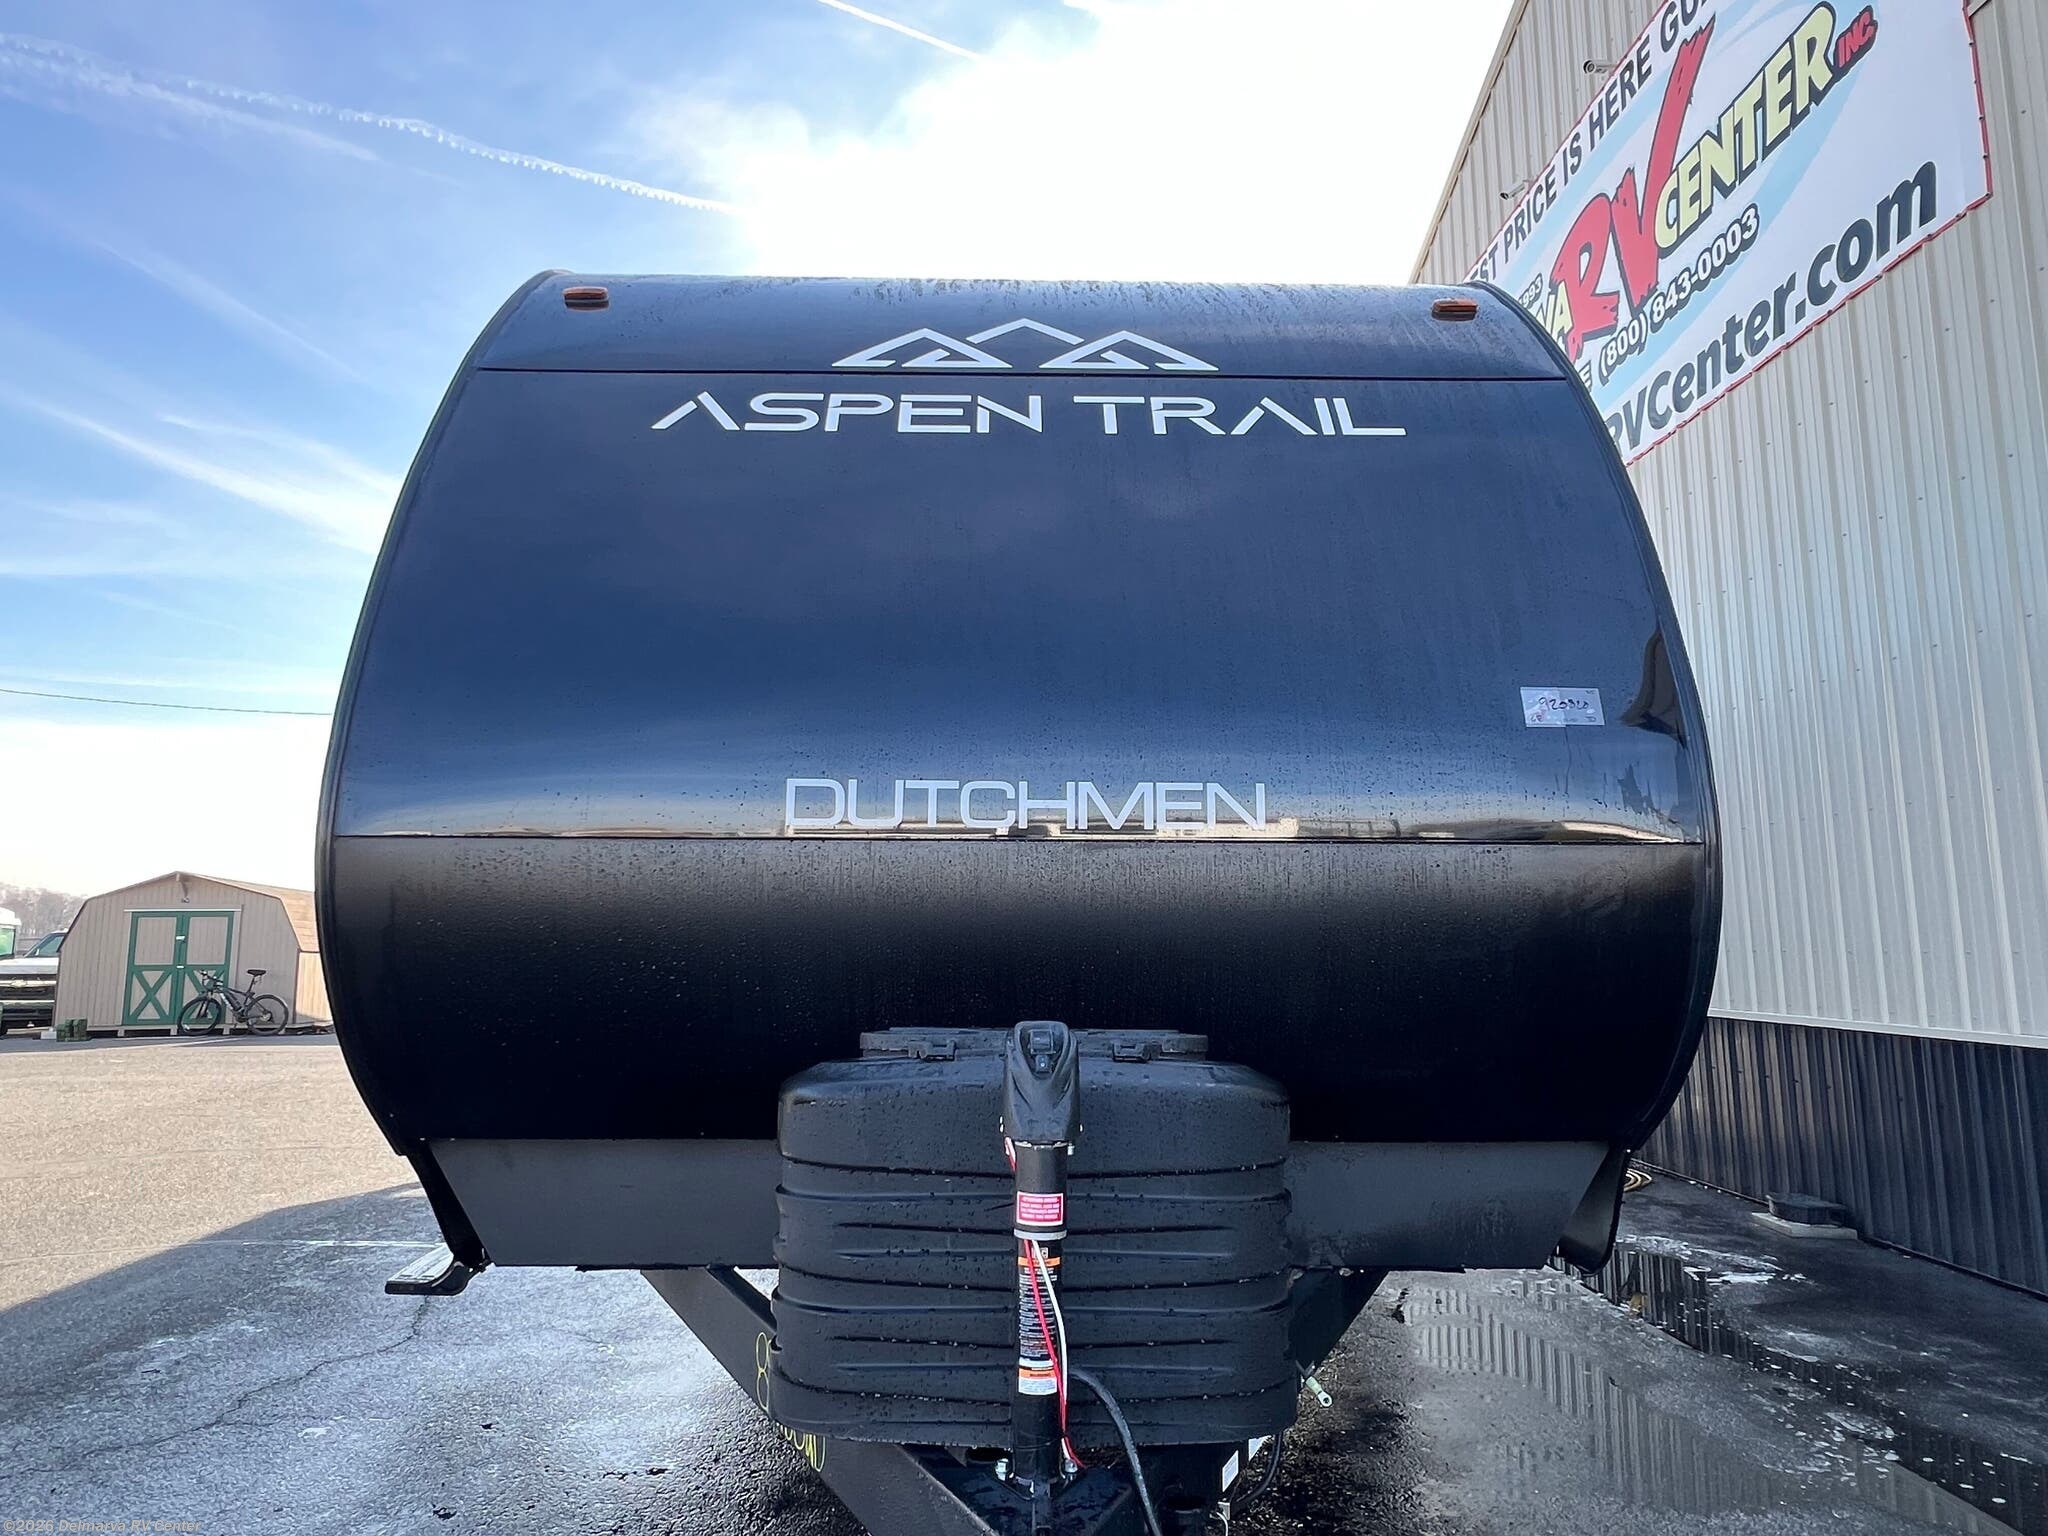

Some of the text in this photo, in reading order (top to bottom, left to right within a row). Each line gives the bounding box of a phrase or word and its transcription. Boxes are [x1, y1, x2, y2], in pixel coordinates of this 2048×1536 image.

[1503, 165, 1557, 265] PRICE
[1562, 132, 1582, 187] IS
[1588, 34, 1652, 152] HERE
[1549, 11, 1716, 366] RV
[1655, 4, 1836, 252] CENTER
[1600, 206, 1758, 379] (800) 843-0003
[1605, 161, 1937, 451] RVCenter.com
[651, 391, 1407, 436] ASPEN TRAIL
[785, 778, 1266, 831] DUTCHMEN
